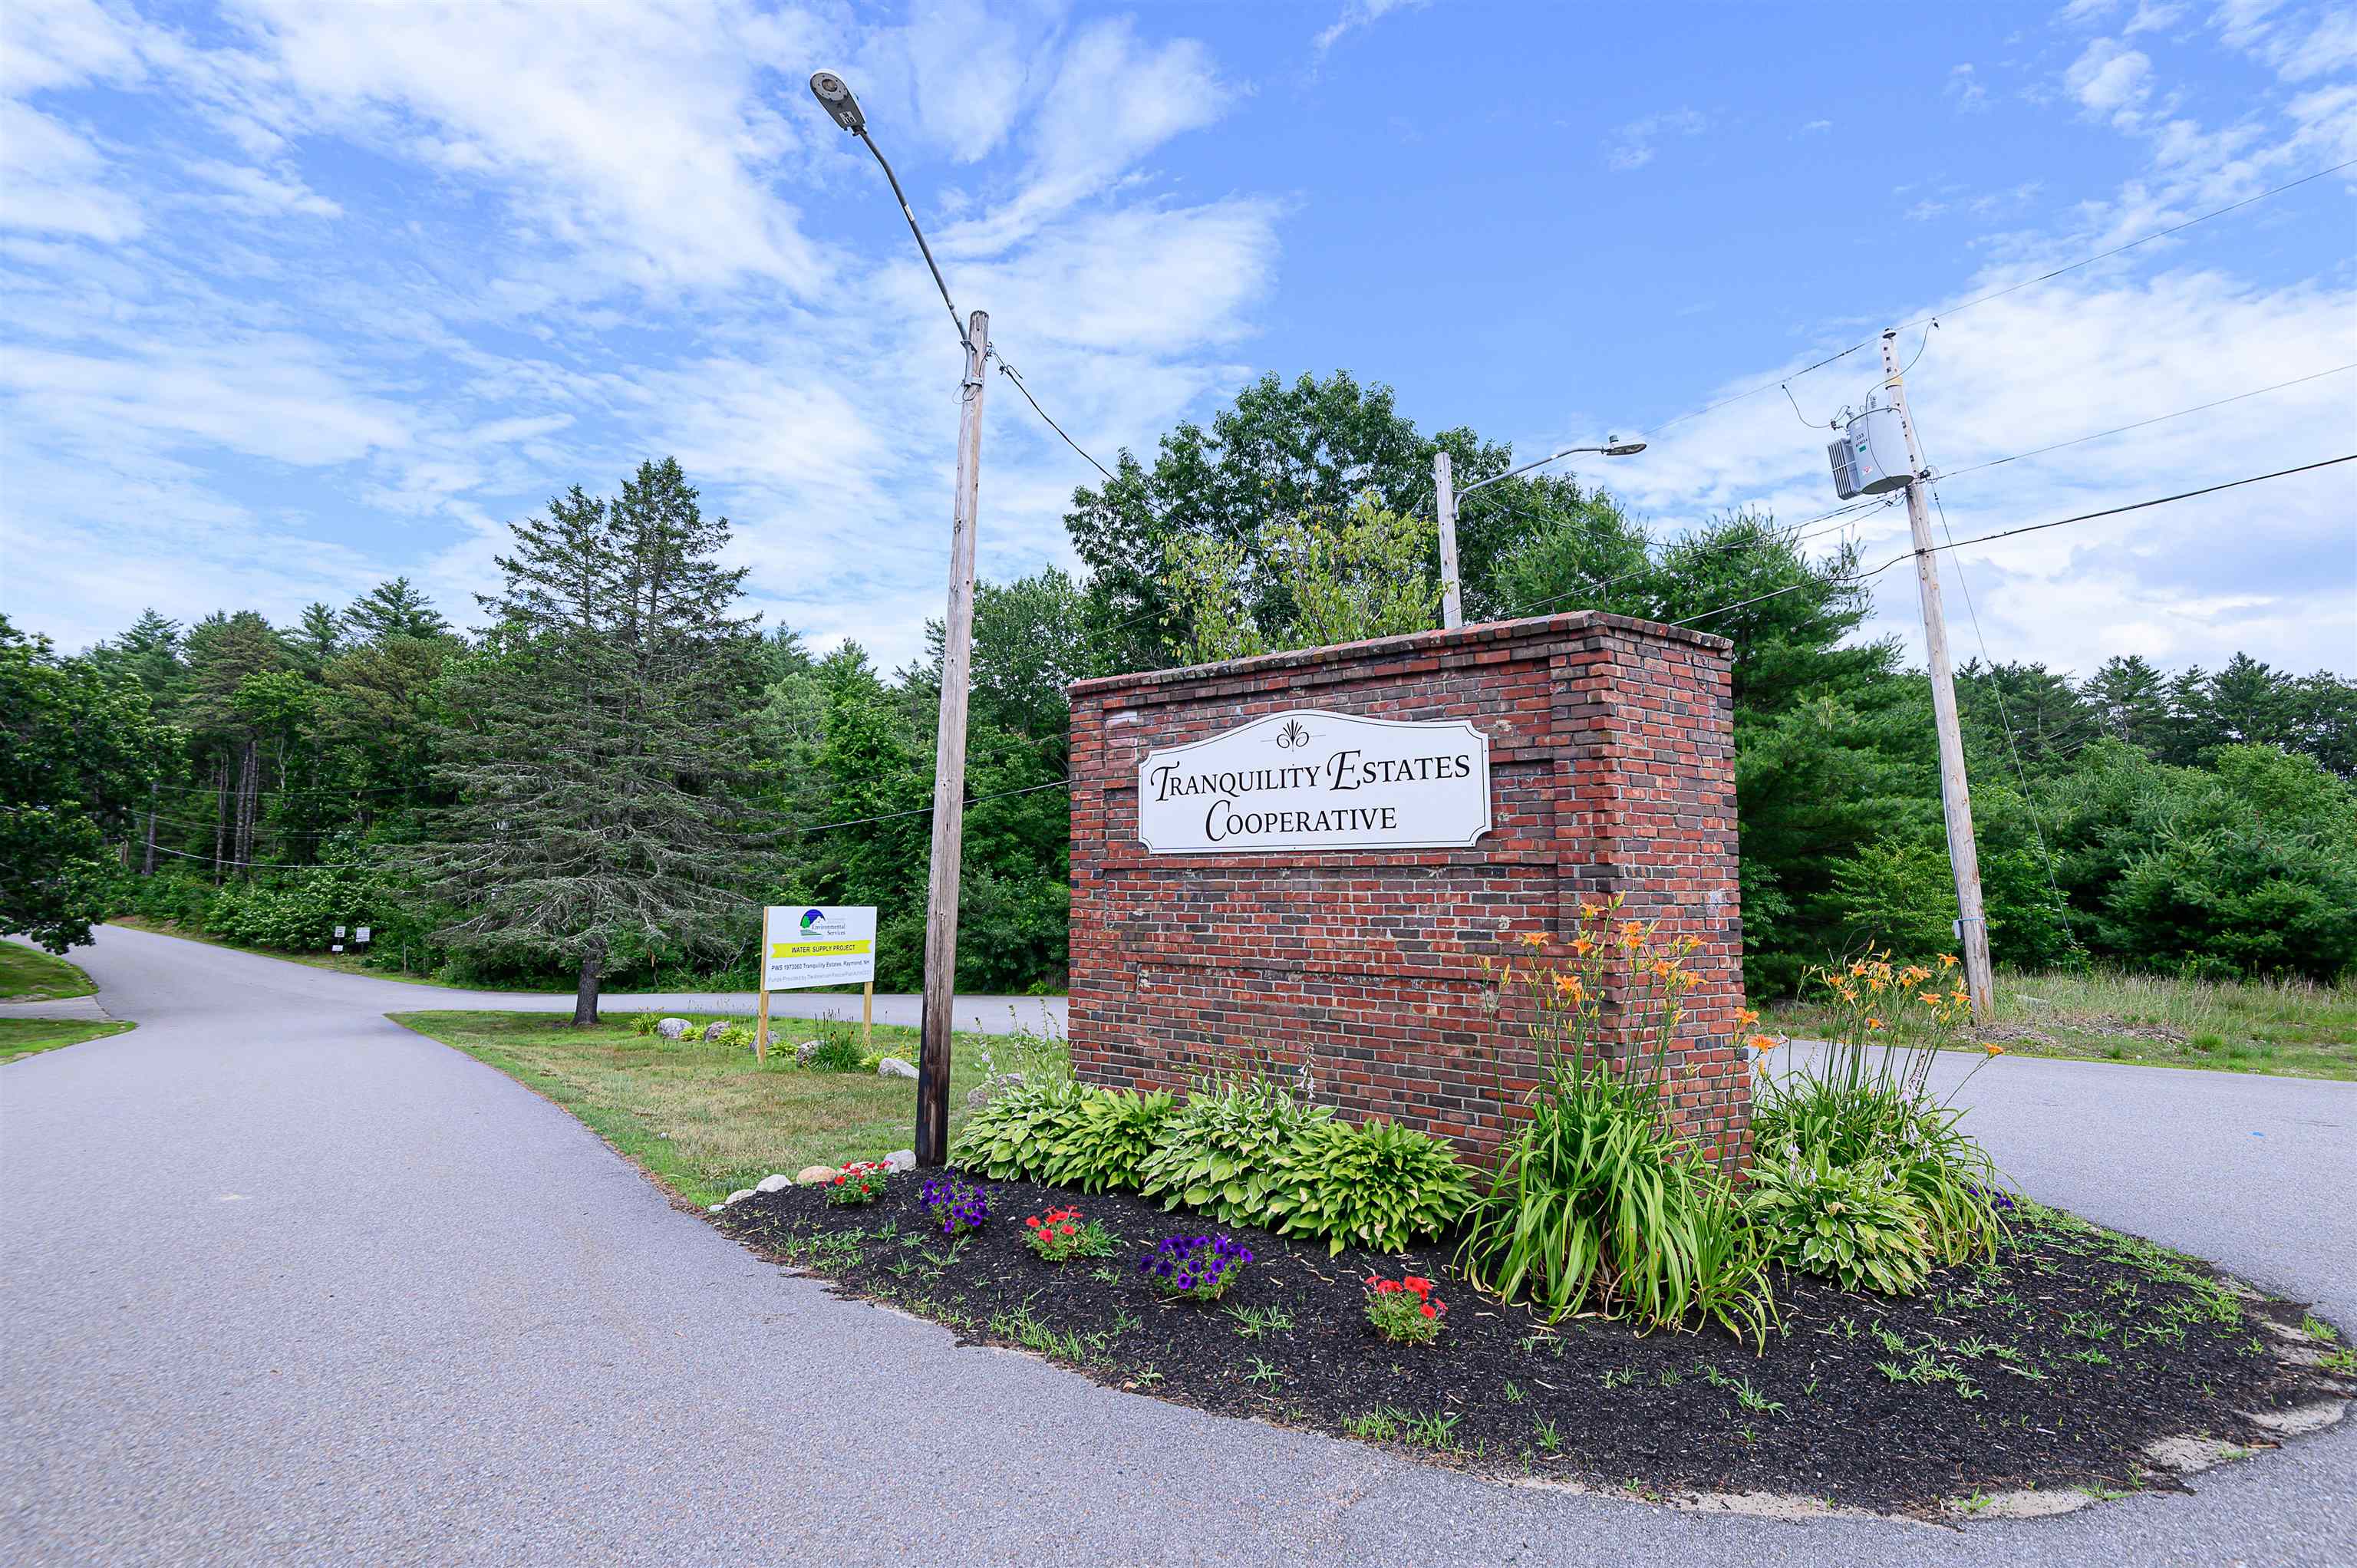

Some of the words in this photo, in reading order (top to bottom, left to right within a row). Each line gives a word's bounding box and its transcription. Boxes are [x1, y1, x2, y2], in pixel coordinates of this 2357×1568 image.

[1151, 761, 1320, 802] TRANQUILITY
[1327, 749, 1471, 791] ESTATES
[1205, 799, 1397, 842] COOPERATIVE
